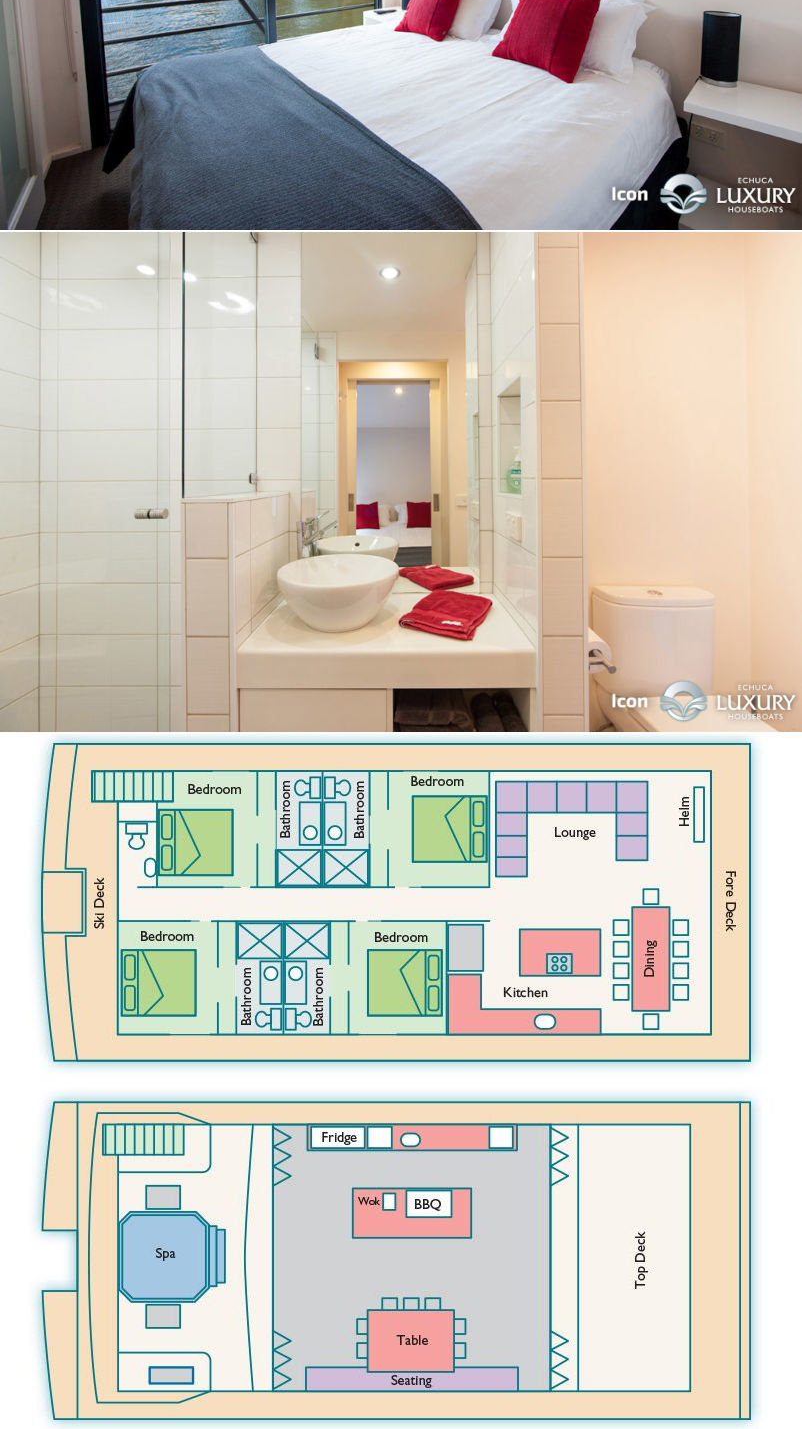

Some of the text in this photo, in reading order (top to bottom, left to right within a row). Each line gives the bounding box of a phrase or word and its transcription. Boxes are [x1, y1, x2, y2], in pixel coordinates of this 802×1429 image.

[411, 775, 464, 787] Bedroom
[187, 783, 242, 795] Bedroom
[279, 780, 291, 839] Bathroom
[353, 781, 365, 839] Bathroom
[679, 796, 690, 827] Helm
[554, 826, 596, 841] Lounge
[94, 877, 105, 929] Ski Deck
[725, 871, 736, 931] Fore Deck
[140, 930, 194, 942] Bedroom
[374, 931, 428, 943] Bedroom
[644, 940, 657, 977] Dining
[240, 967, 252, 1026] Bathroom
[312, 967, 324, 1026] Bathroom
[503, 986, 548, 998] Kitchen
[321, 1131, 357, 1146] Fridge
[358, 1196, 380, 1206] Wok
[414, 1198, 442, 1212] BBQ
[155, 1247, 176, 1262] Spa
[635, 1231, 648, 1290] Top Deck
[396, 1334, 429, 1346] Table
[391, 1374, 432, 1389] Seating
